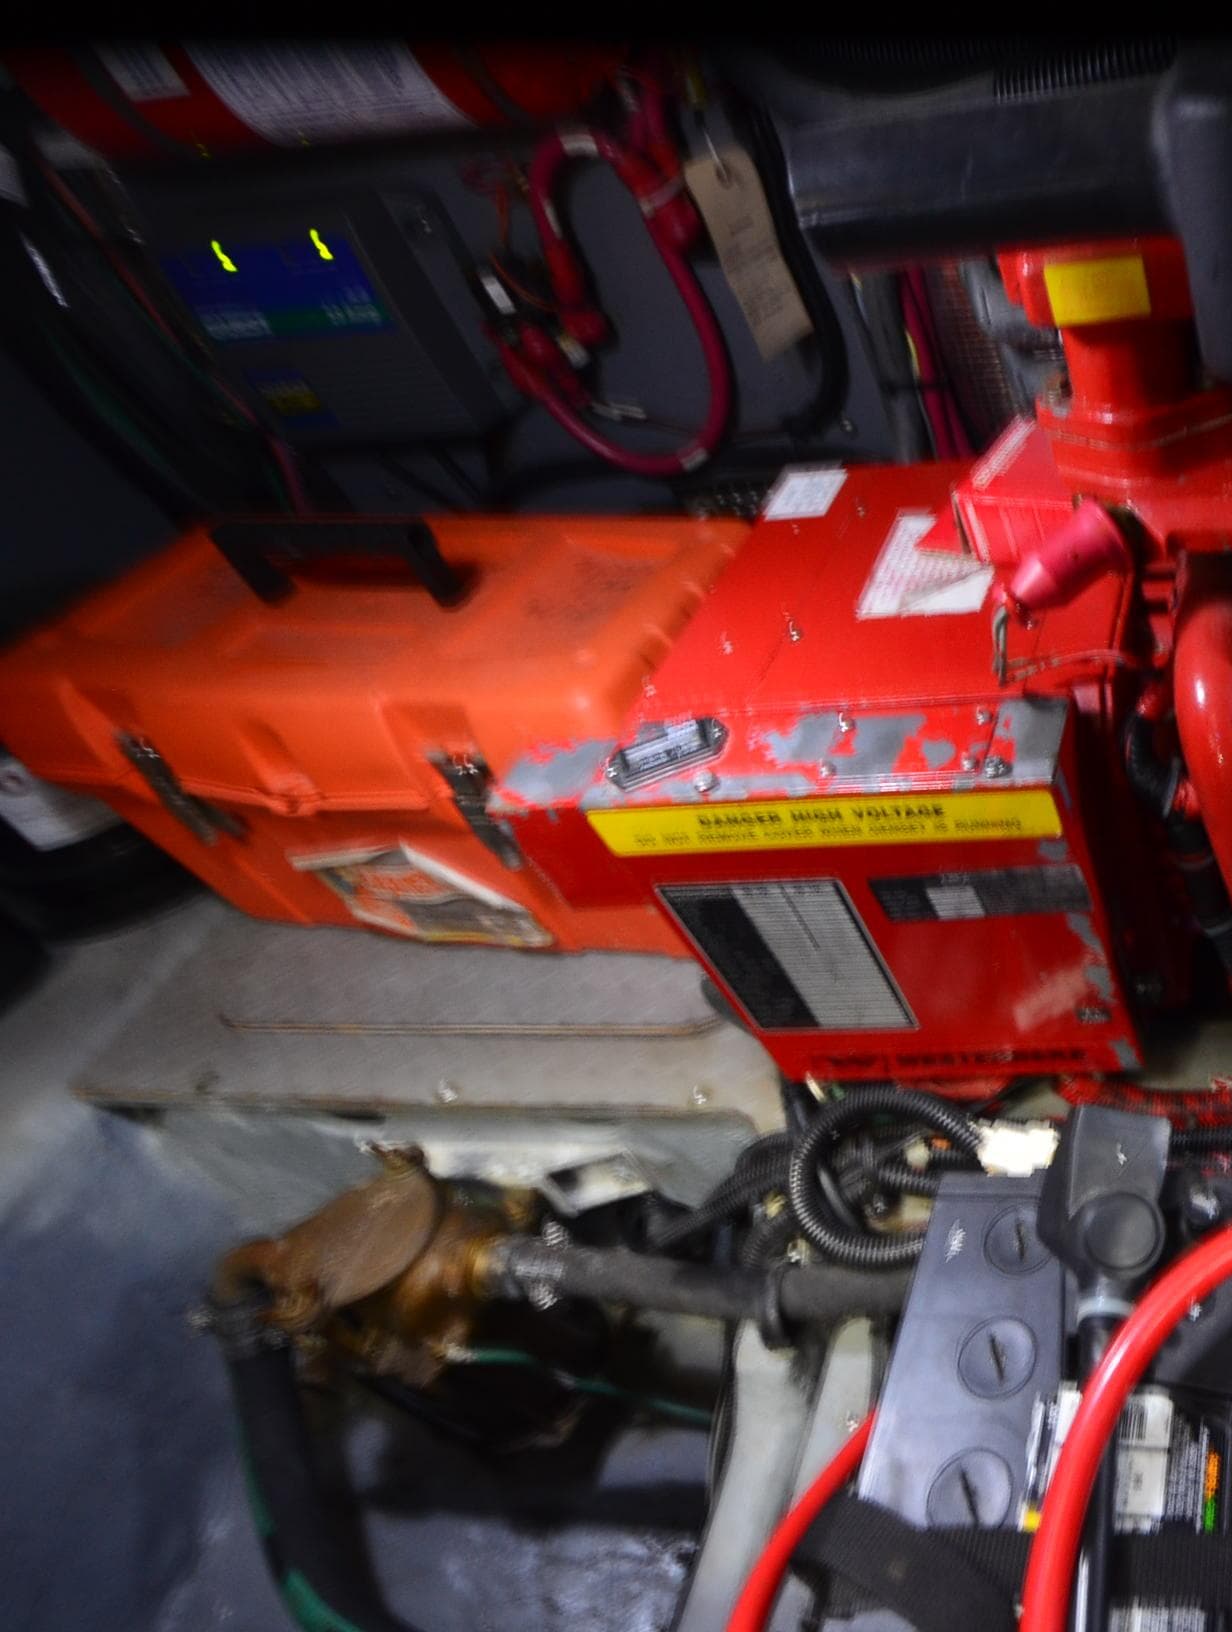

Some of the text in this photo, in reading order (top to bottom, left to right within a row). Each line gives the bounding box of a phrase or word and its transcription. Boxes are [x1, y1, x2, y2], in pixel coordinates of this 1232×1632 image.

[698, 803, 944, 828] DANGER HIGH VOLTAGE
[697, 829, 756, 843] REMOVE
[763, 827, 814, 841] COVER
[954, 816, 1022, 832] RUNNING
